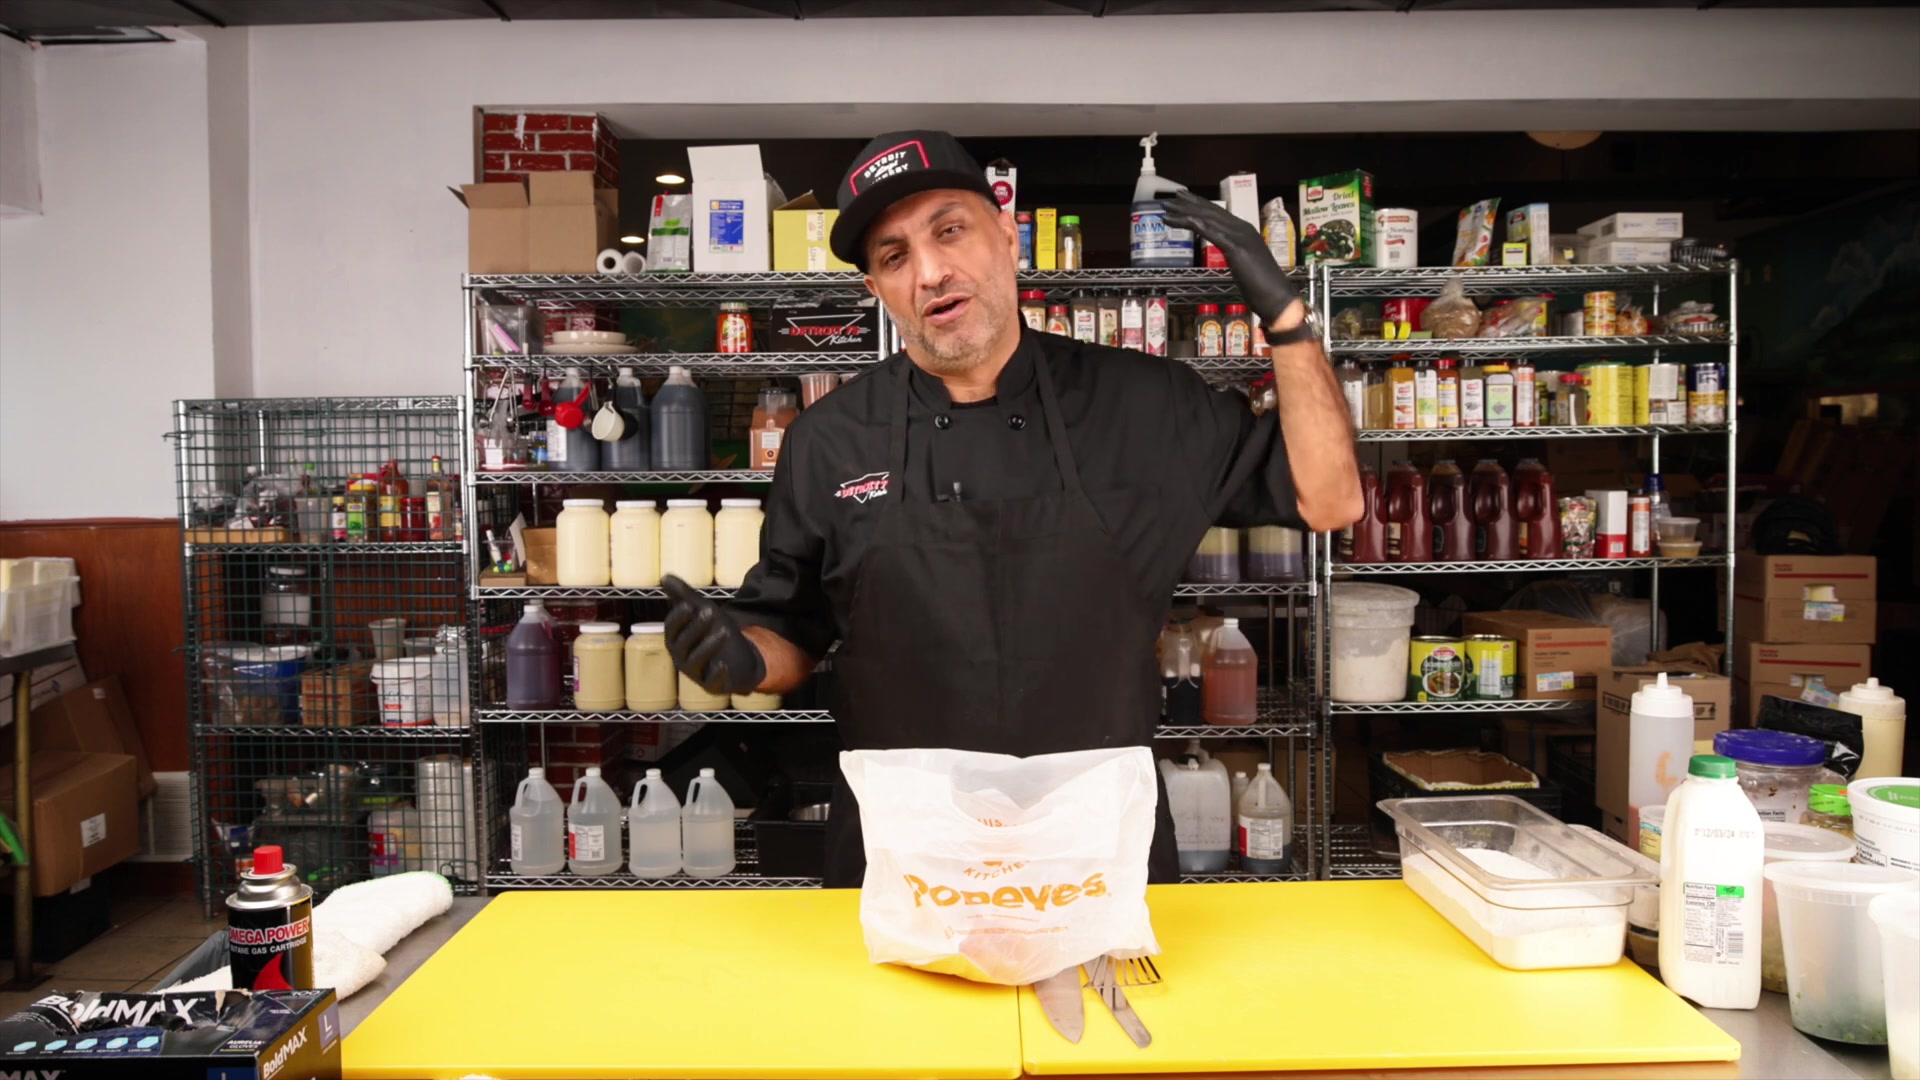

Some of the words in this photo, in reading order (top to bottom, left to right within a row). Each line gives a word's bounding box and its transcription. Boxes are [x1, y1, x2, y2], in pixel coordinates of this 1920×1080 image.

[1134, 223, 1166, 234] DAWN
[790, 326, 842, 336] DETROIT
[829, 336, 862, 346] Kitchen
[963, 857, 1031, 880] KITCHE
[266, 917, 311, 943] POWER
[251, 947, 268, 955] GAS
[269, 936, 308, 953] CARTRIDGE
[262, 1027, 309, 1080] BoldMAX
